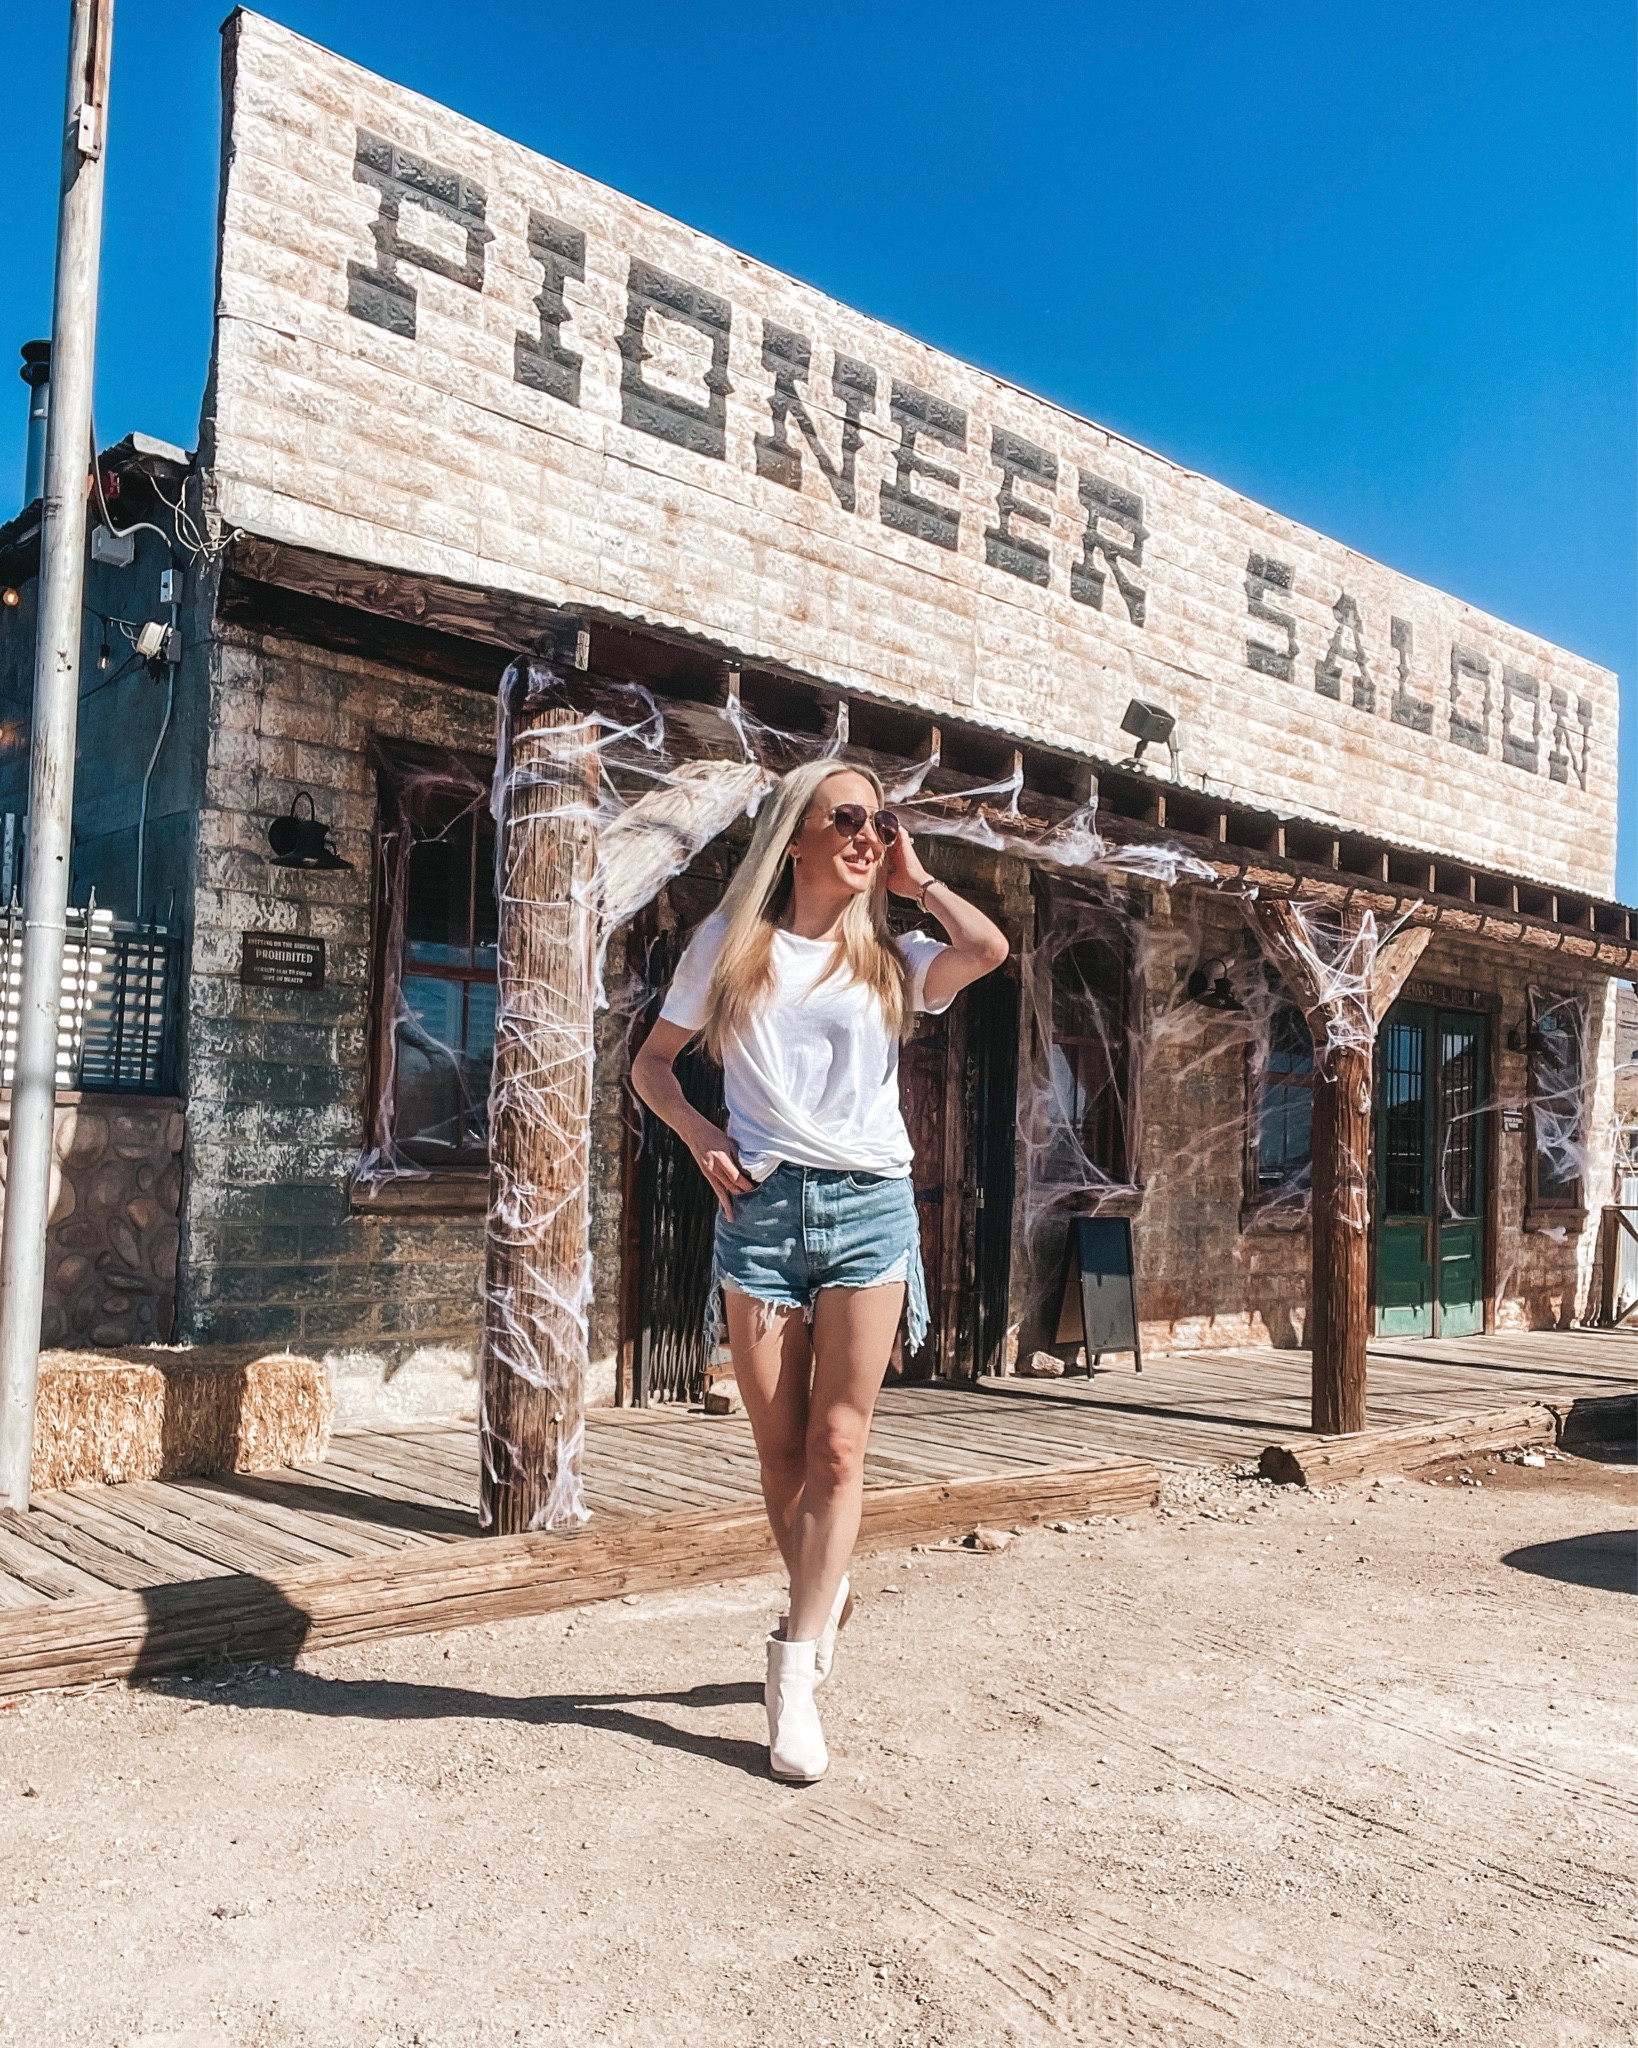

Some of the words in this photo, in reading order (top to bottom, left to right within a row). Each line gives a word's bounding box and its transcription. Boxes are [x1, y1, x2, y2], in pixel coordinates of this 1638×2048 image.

[347, 127, 1150, 627] PIONEER
[1244, 549, 1593, 791] SALOON
[255, 948, 313, 964] PROHIBITED
